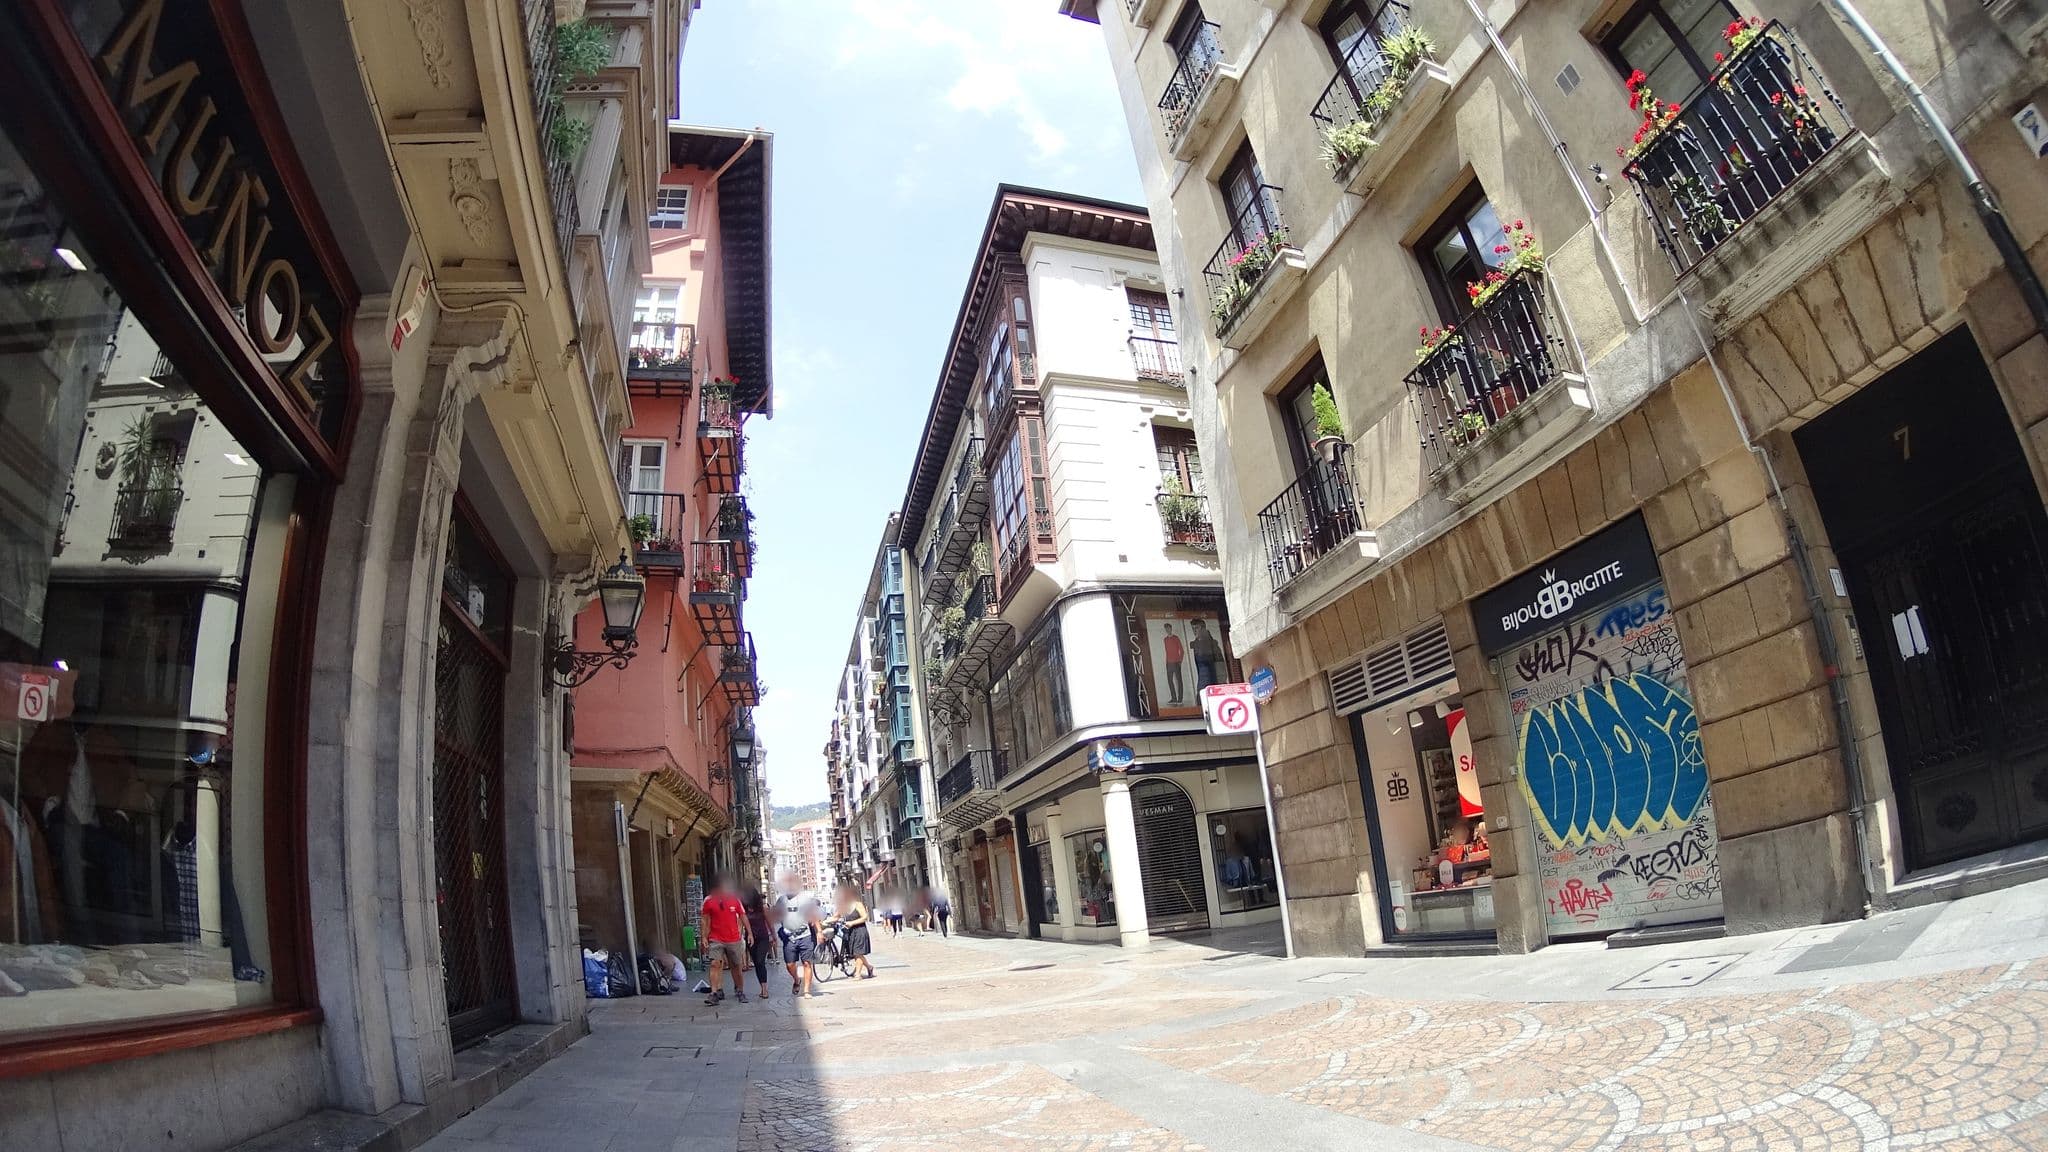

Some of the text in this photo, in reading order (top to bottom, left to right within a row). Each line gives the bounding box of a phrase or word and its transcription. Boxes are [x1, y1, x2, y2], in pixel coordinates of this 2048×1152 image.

[1893, 425, 1911, 460] 7
[1501, 602, 1539, 631] BIJOU
[1119, 596, 1151, 716] VESMAN
